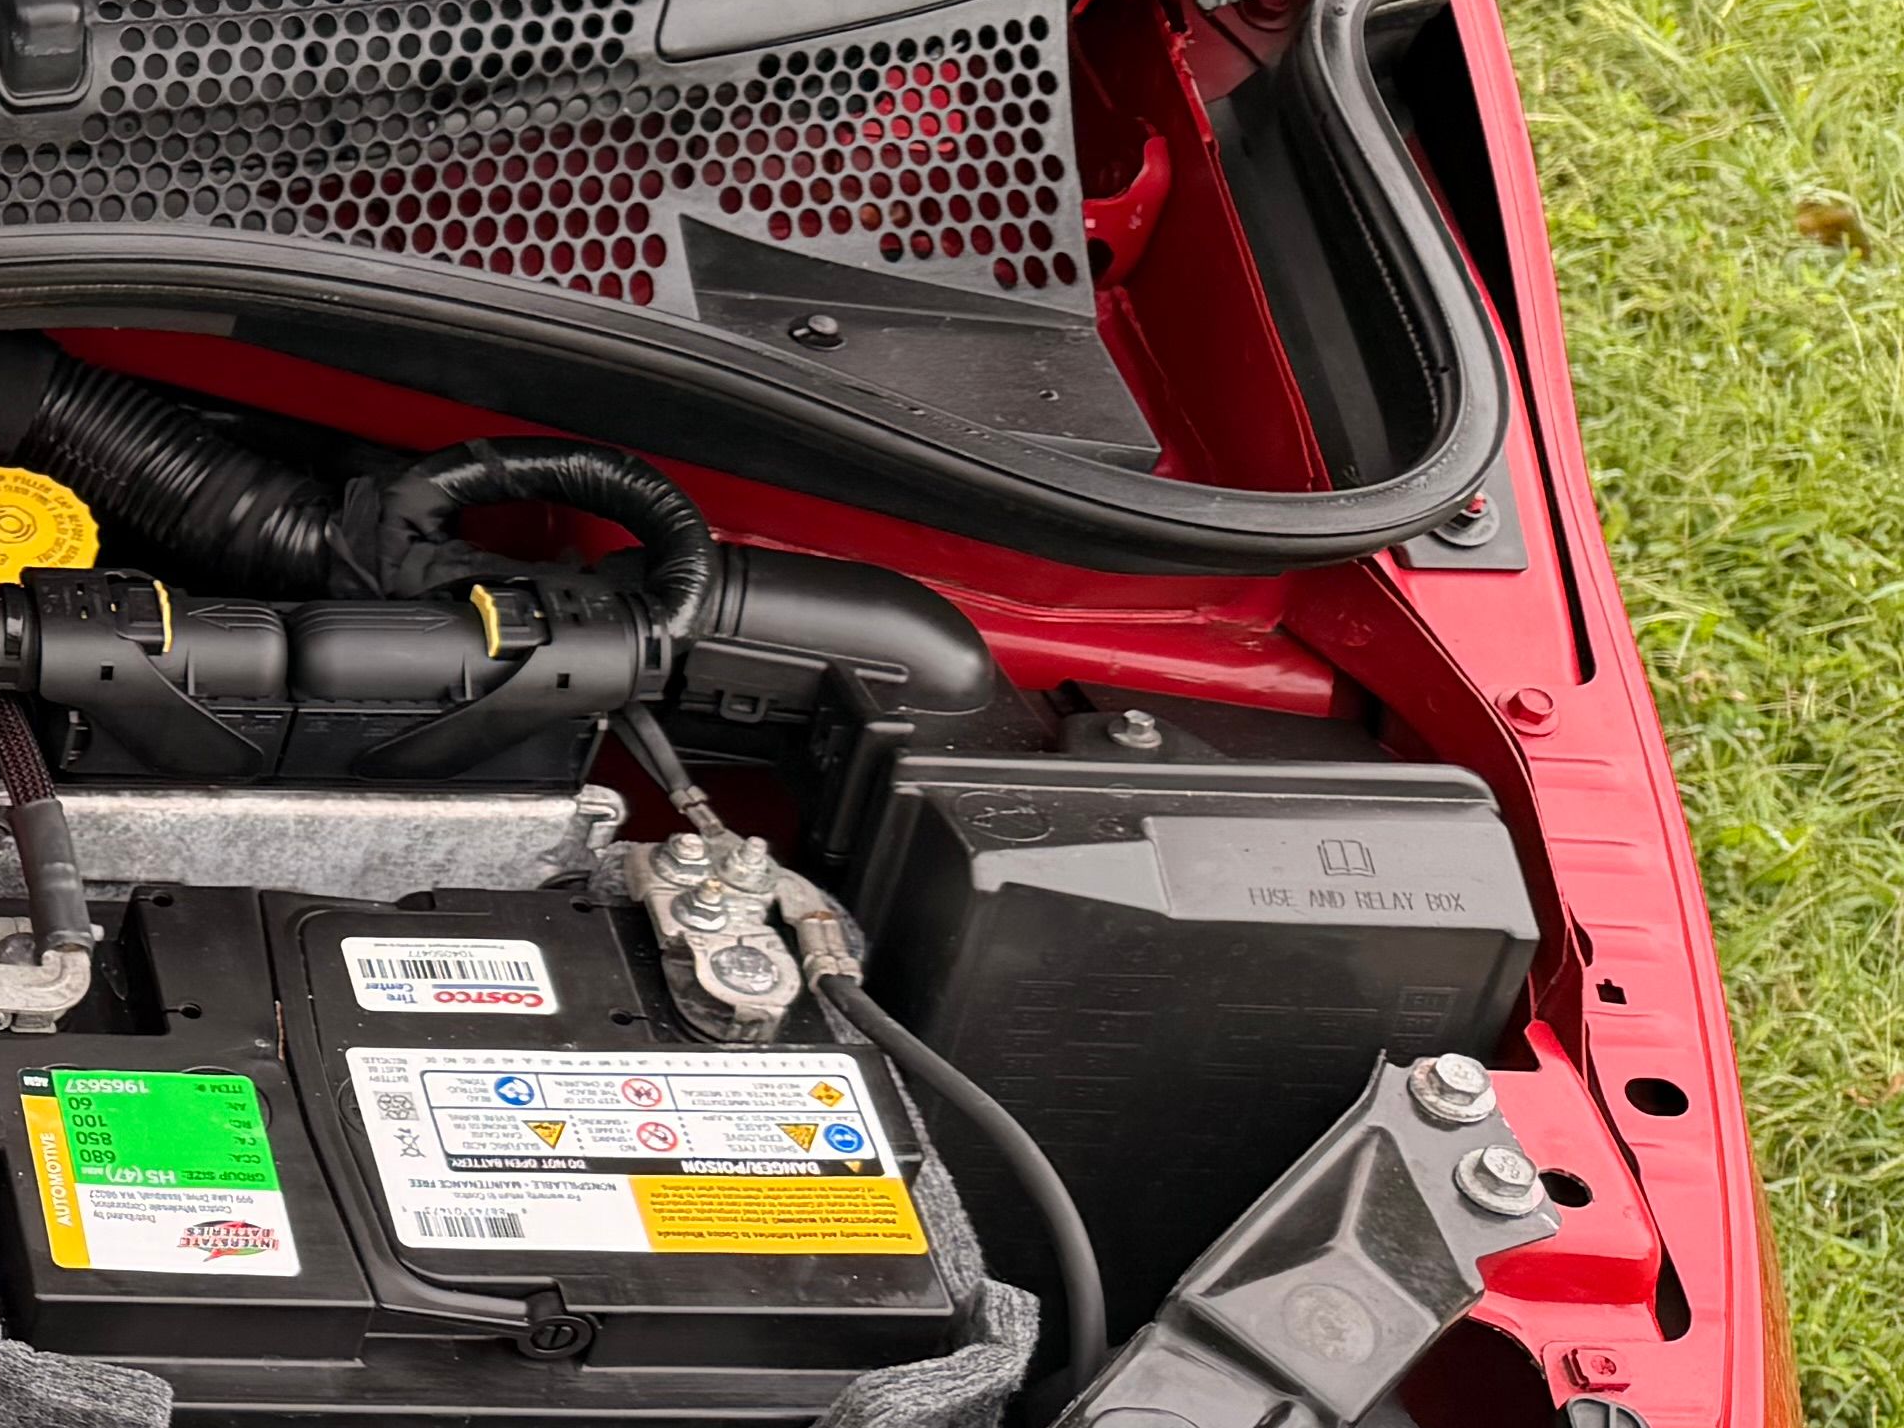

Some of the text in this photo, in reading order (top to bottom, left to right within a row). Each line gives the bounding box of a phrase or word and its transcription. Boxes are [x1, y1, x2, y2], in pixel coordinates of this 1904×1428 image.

[1248, 887, 1466, 913] FUSE AND RELAY BOX
[364, 982, 415, 993] Center
[386, 993, 419, 1005] Tire
[433, 990, 544, 1008] COSTCO
[63, 1077, 150, 1094] 1965637
[68, 1097, 92, 1110] 60
[72, 1114, 108, 1128] 100
[75, 1131, 112, 1146] 850
[79, 1149, 116, 1164] 680
[450, 1157, 587, 1169] DO NOT OPEN BATTERY
[680, 1160, 821, 1176] DANGER/POISON
[39, 1131, 75, 1228] AUTOMOTIVE
[219, 1172, 265, 1182] GROUP
[407, 1178, 617, 1192] NONSPILLABLE MAINTENANCE FREE
[186, 1227, 271, 1238] BATTERIES
[179, 1237, 277, 1249] INTERSTATE
